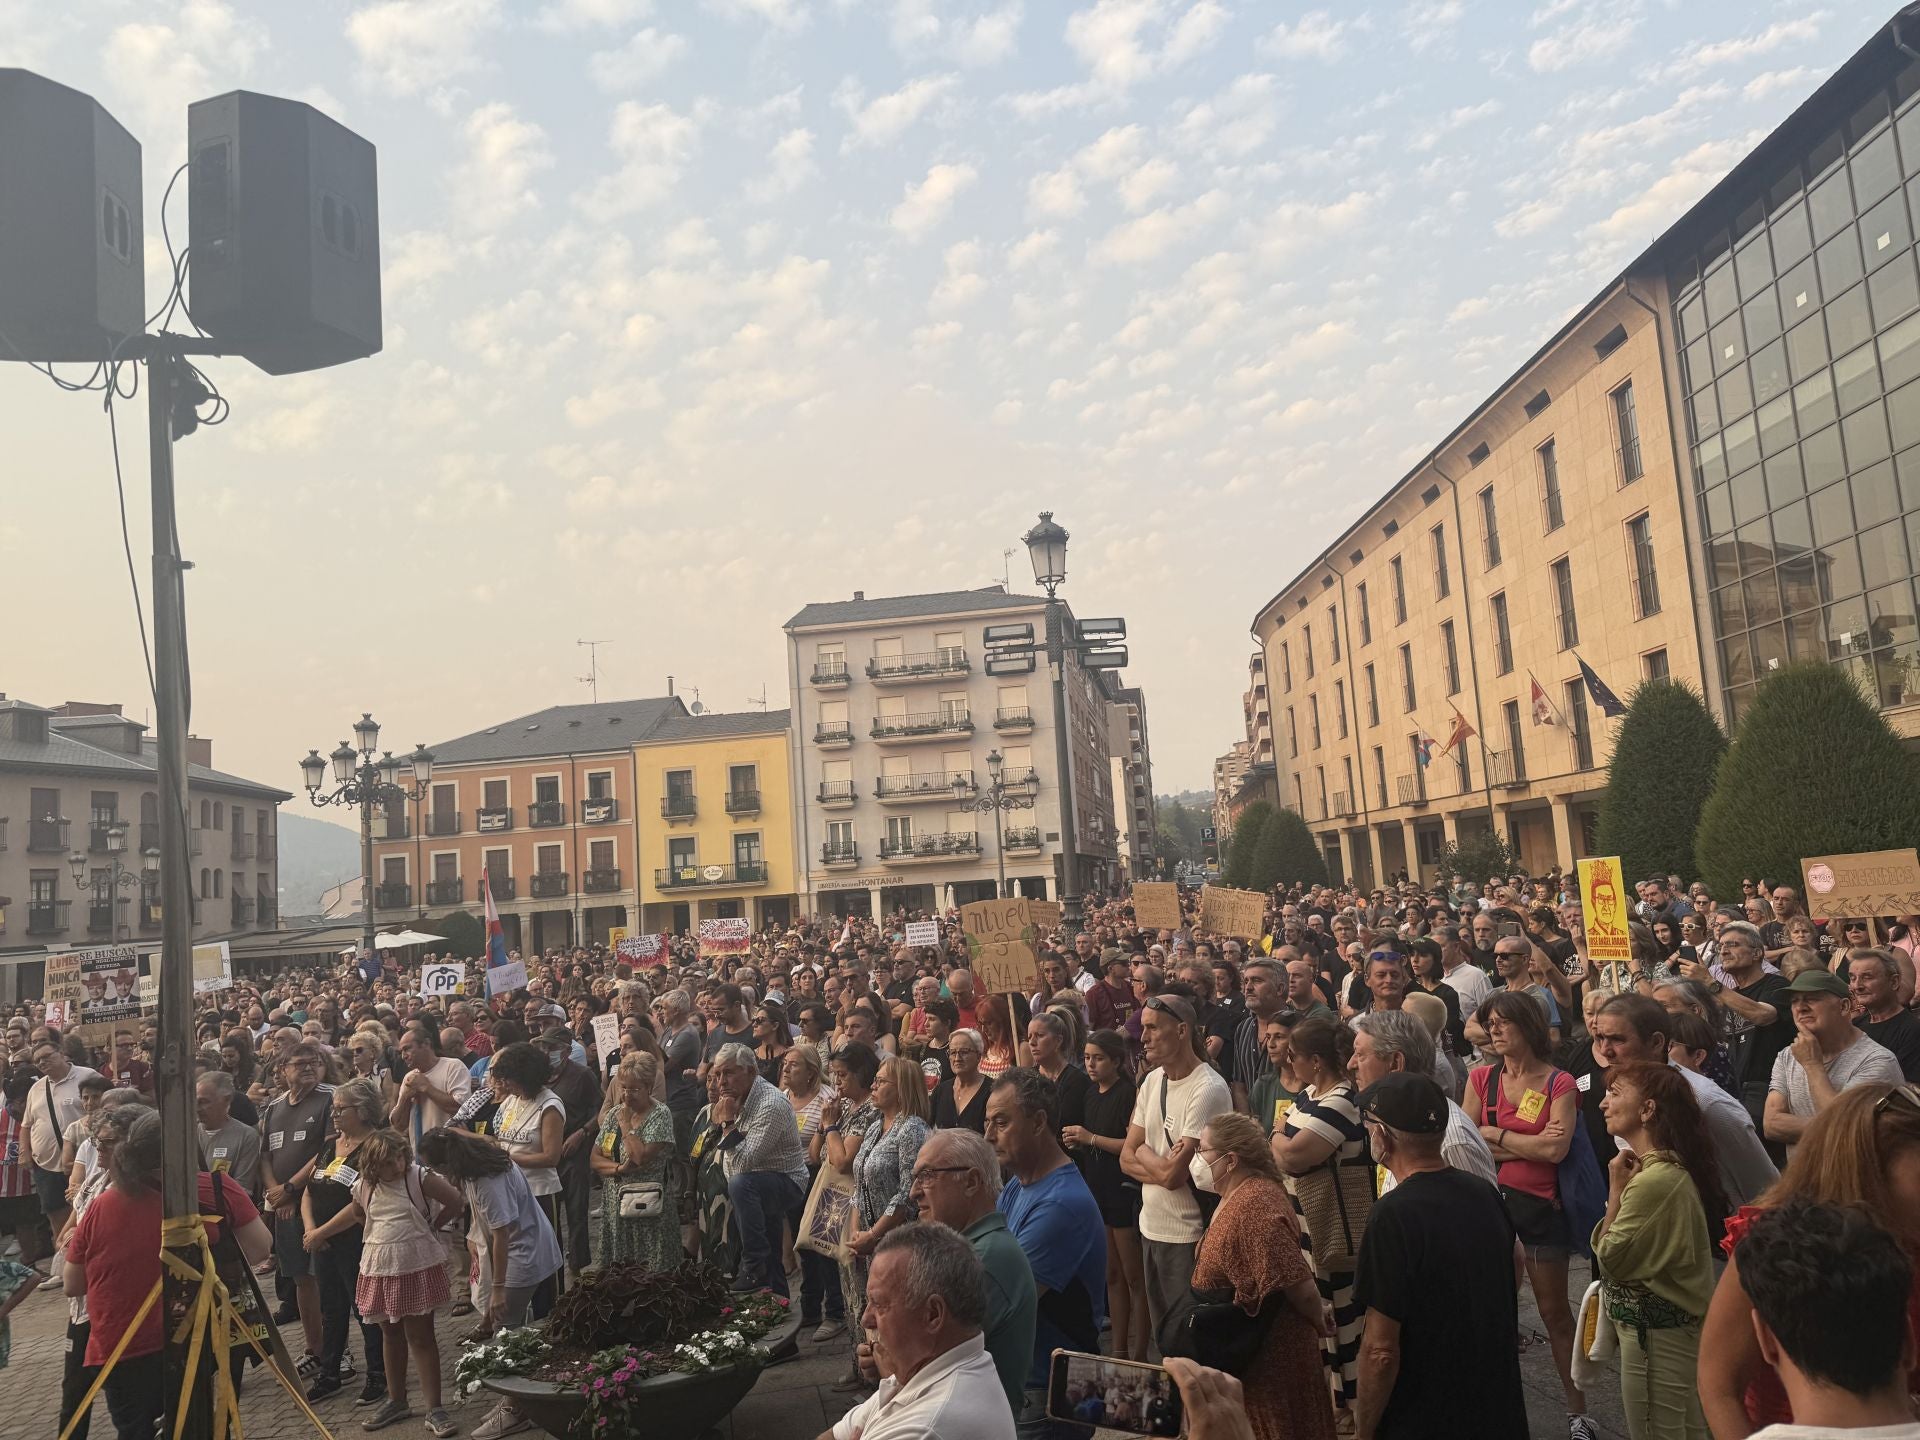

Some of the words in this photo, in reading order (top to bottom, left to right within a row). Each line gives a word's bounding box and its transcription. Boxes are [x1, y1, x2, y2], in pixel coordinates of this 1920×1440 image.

[858, 876, 904, 886] HONTANAR
[1839, 866, 1914, 887] INCENDIOS
[1208, 898, 1256, 915] TERRORISMO
[1202, 914, 1261, 935] AMBIENTAL
[80, 951, 92, 960] SE
[95, 946, 136, 959] BUSCAN
[993, 932, 1009, 956] 3
[48, 969, 80, 987] NUNCA
